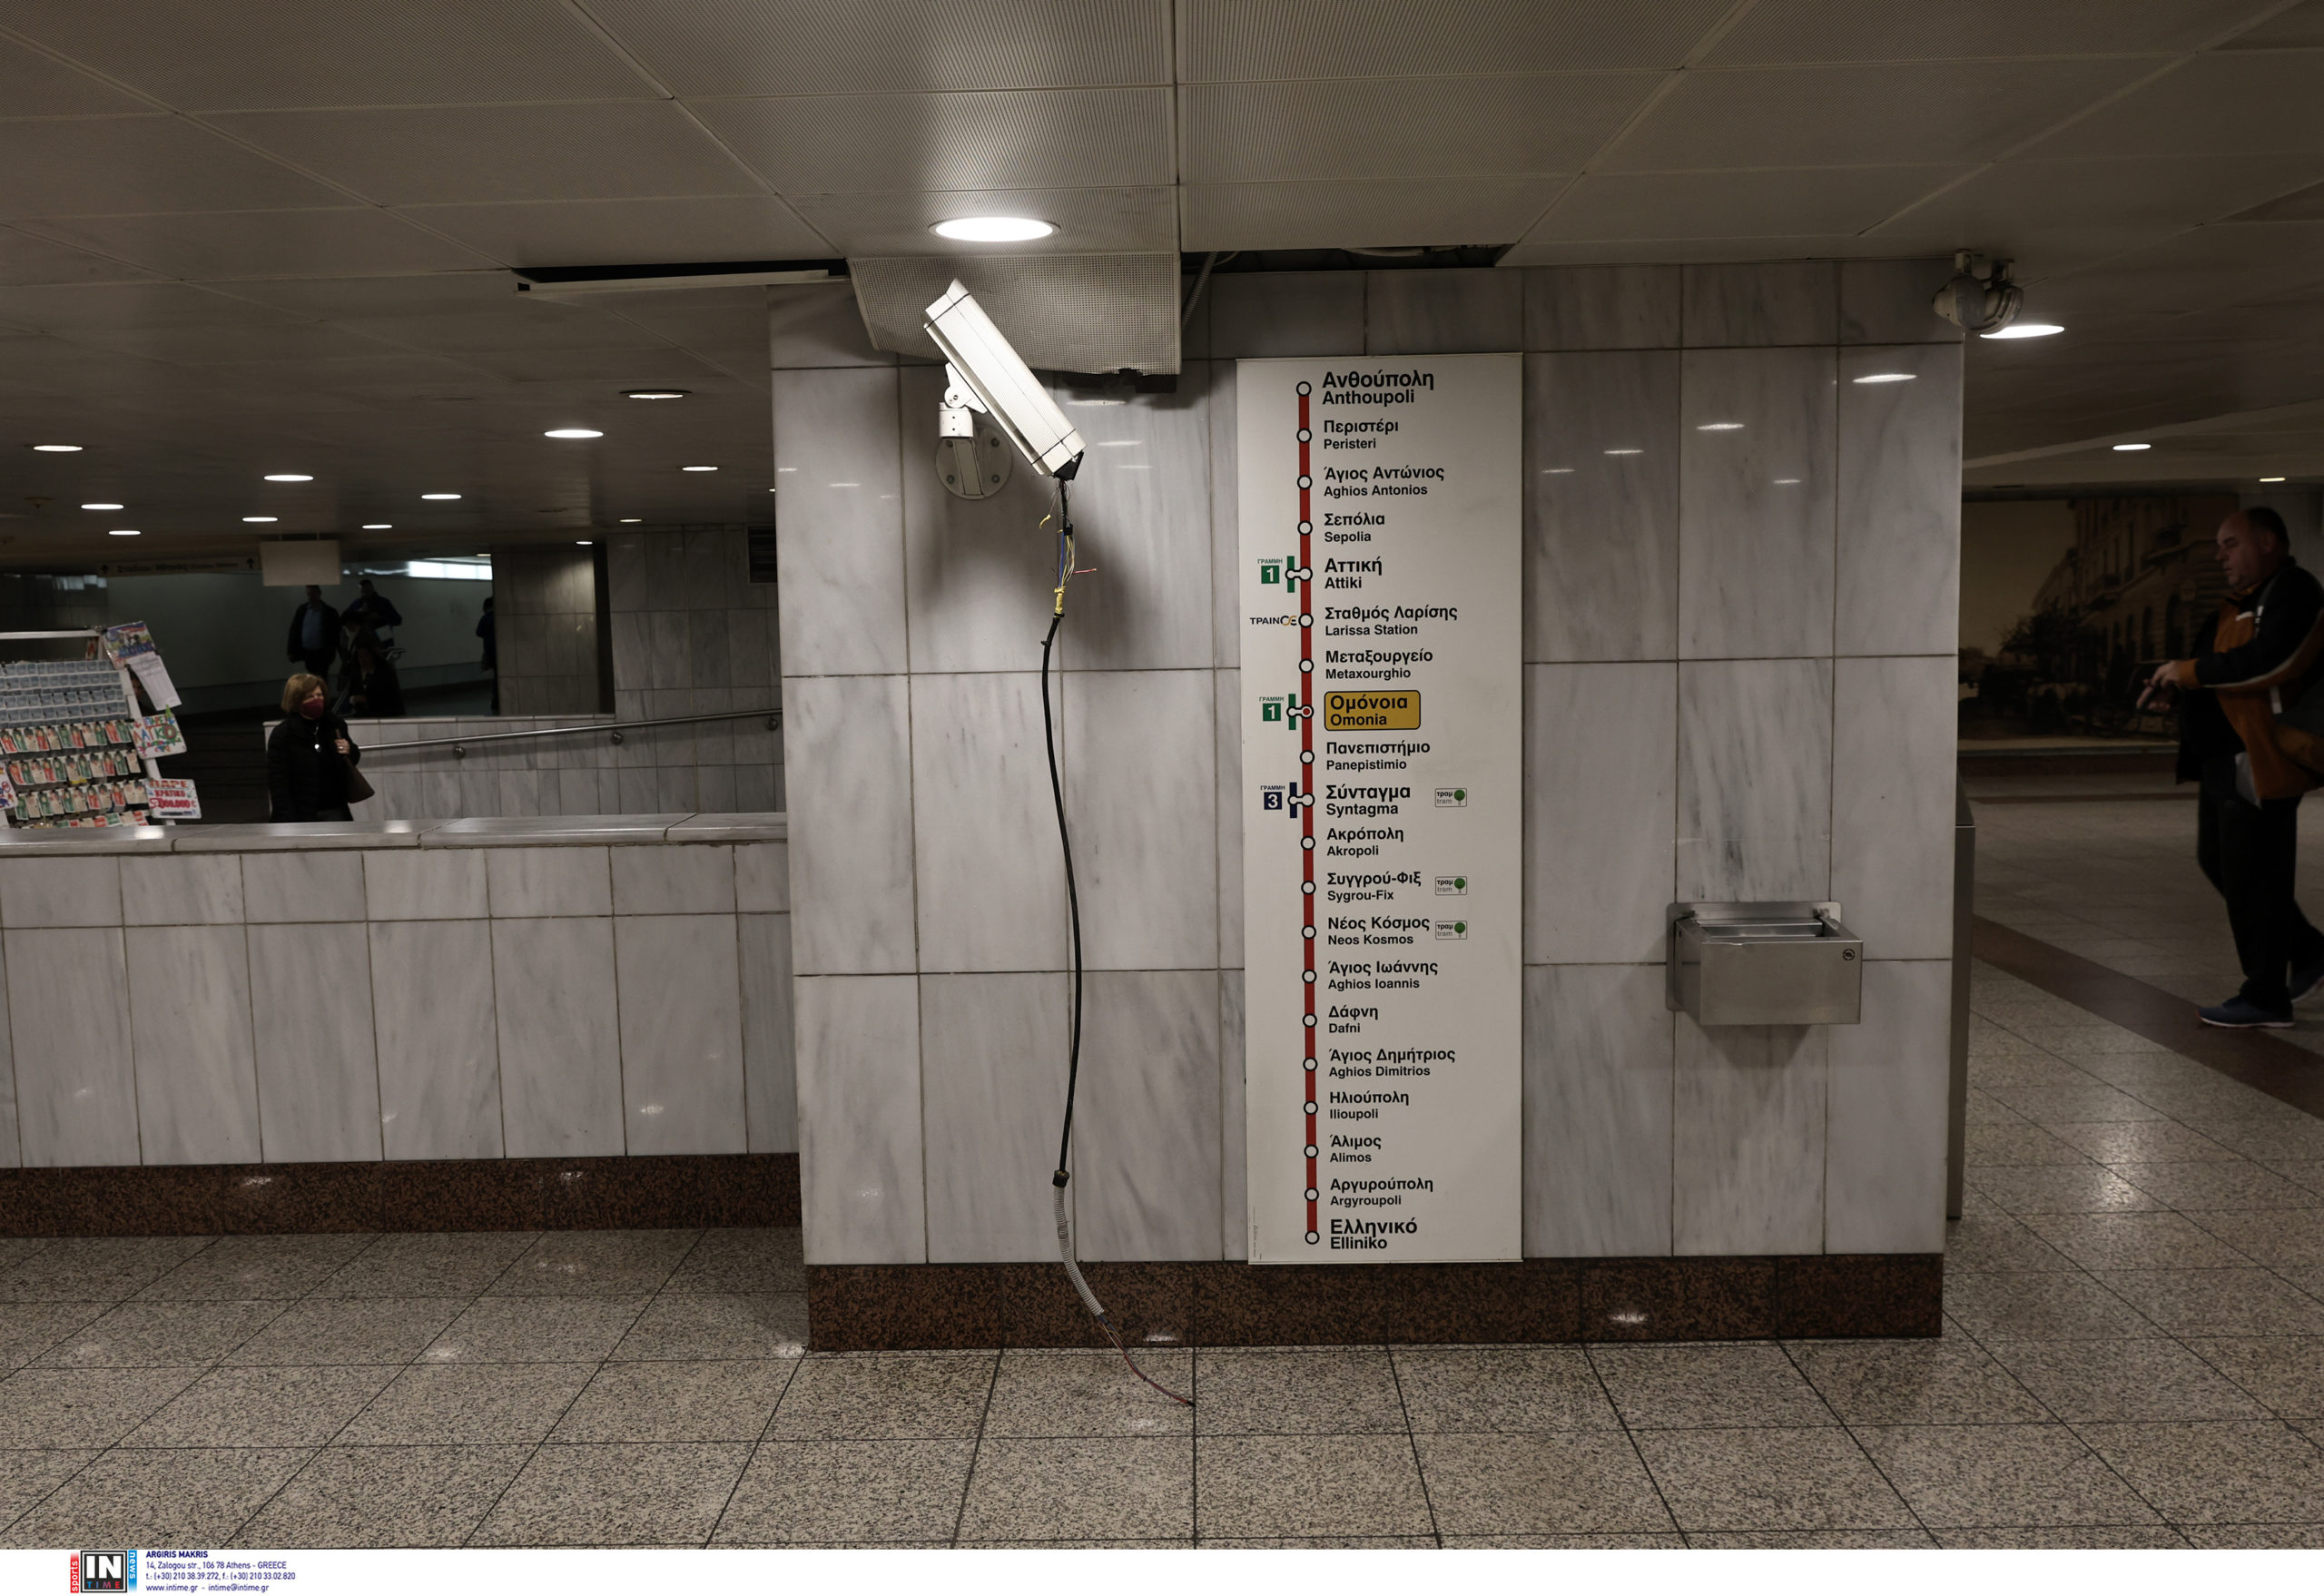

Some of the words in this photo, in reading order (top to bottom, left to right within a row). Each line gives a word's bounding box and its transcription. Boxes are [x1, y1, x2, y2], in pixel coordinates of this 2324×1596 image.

[1323, 369, 1433, 389] Ανθούπολη
[1323, 389, 1414, 407] Anthoupoli
[1324, 419, 1398, 436] Περιστέρι
[1324, 438, 1375, 448] Peristeri
[1324, 467, 1368, 482] Άγιος
[1373, 465, 1444, 481] Αντώνιος
[1324, 486, 1367, 498] Aghios
[1372, 485, 1427, 495] Antonios
[1324, 512, 1384, 526] Σεπόλια
[1324, 531, 1371, 545] Sepolia
[1324, 557, 1382, 576] Αττική
[1324, 576, 1362, 588] Attiki
[1325, 606, 1389, 622] Σταθμός
[1394, 605, 1457, 621] Λαρίσης
[1325, 626, 1370, 635] Larissa
[1374, 625, 1417, 635] Station
[1326, 648, 1433, 665] Μεταξουργείο
[1326, 668, 1411, 681] Metaxourghio
[1331, 695, 1407, 714] Ομόνοια
[1331, 714, 1387, 725] Omonia
[1327, 740, 1430, 756] Πανεπιστήμιο
[1327, 759, 1406, 773] Panepistimio
[1326, 783, 1410, 802] Σύνταγμα
[1436, 791, 1453, 799] τραμ
[1267, 793, 1278, 808] 3
[1326, 803, 1398, 818] Syntagma
[1327, 827, 1403, 842] Ακρόπολη
[1327, 845, 1378, 858] Akropoli
[1327, 872, 1421, 888] Συγγρού-Φιξ
[1328, 890, 1393, 903] Sygrou-Fix
[1328, 917, 1365, 931] Νέος
[1372, 916, 1430, 931] Κόσμος
[1328, 935, 1359, 944] Neos
[1364, 934, 1413, 944] Kosmos
[1328, 961, 1371, 976] Άγιος
[1377, 960, 1438, 975] Ιωάννης
[1328, 980, 1371, 991] Aghios
[1375, 979, 1419, 989] Ioannis
[1329, 1005, 1378, 1020] Δάφνη
[1329, 1023, 1360, 1033] Dafni
[1329, 1049, 1372, 1064] Άγιος
[1376, 1048, 1455, 1063] Δημήτριος
[1329, 1067, 1372, 1079] Aghios
[1376, 1066, 1430, 1076] Dimitrios
[1330, 1090, 1409, 1106] Ηλιούπολη
[1330, 1108, 1378, 1121] Ilioupoli
[1330, 1135, 1381, 1149] Άλιμος
[1330, 1153, 1372, 1162] Alimos
[1331, 1177, 1433, 1193] Αργυρούπολη
[1331, 1196, 1401, 1207] Argyroupoli
[1331, 1217, 1417, 1235] Ελληνικό
[1331, 1236, 1387, 1249] Elliniko
